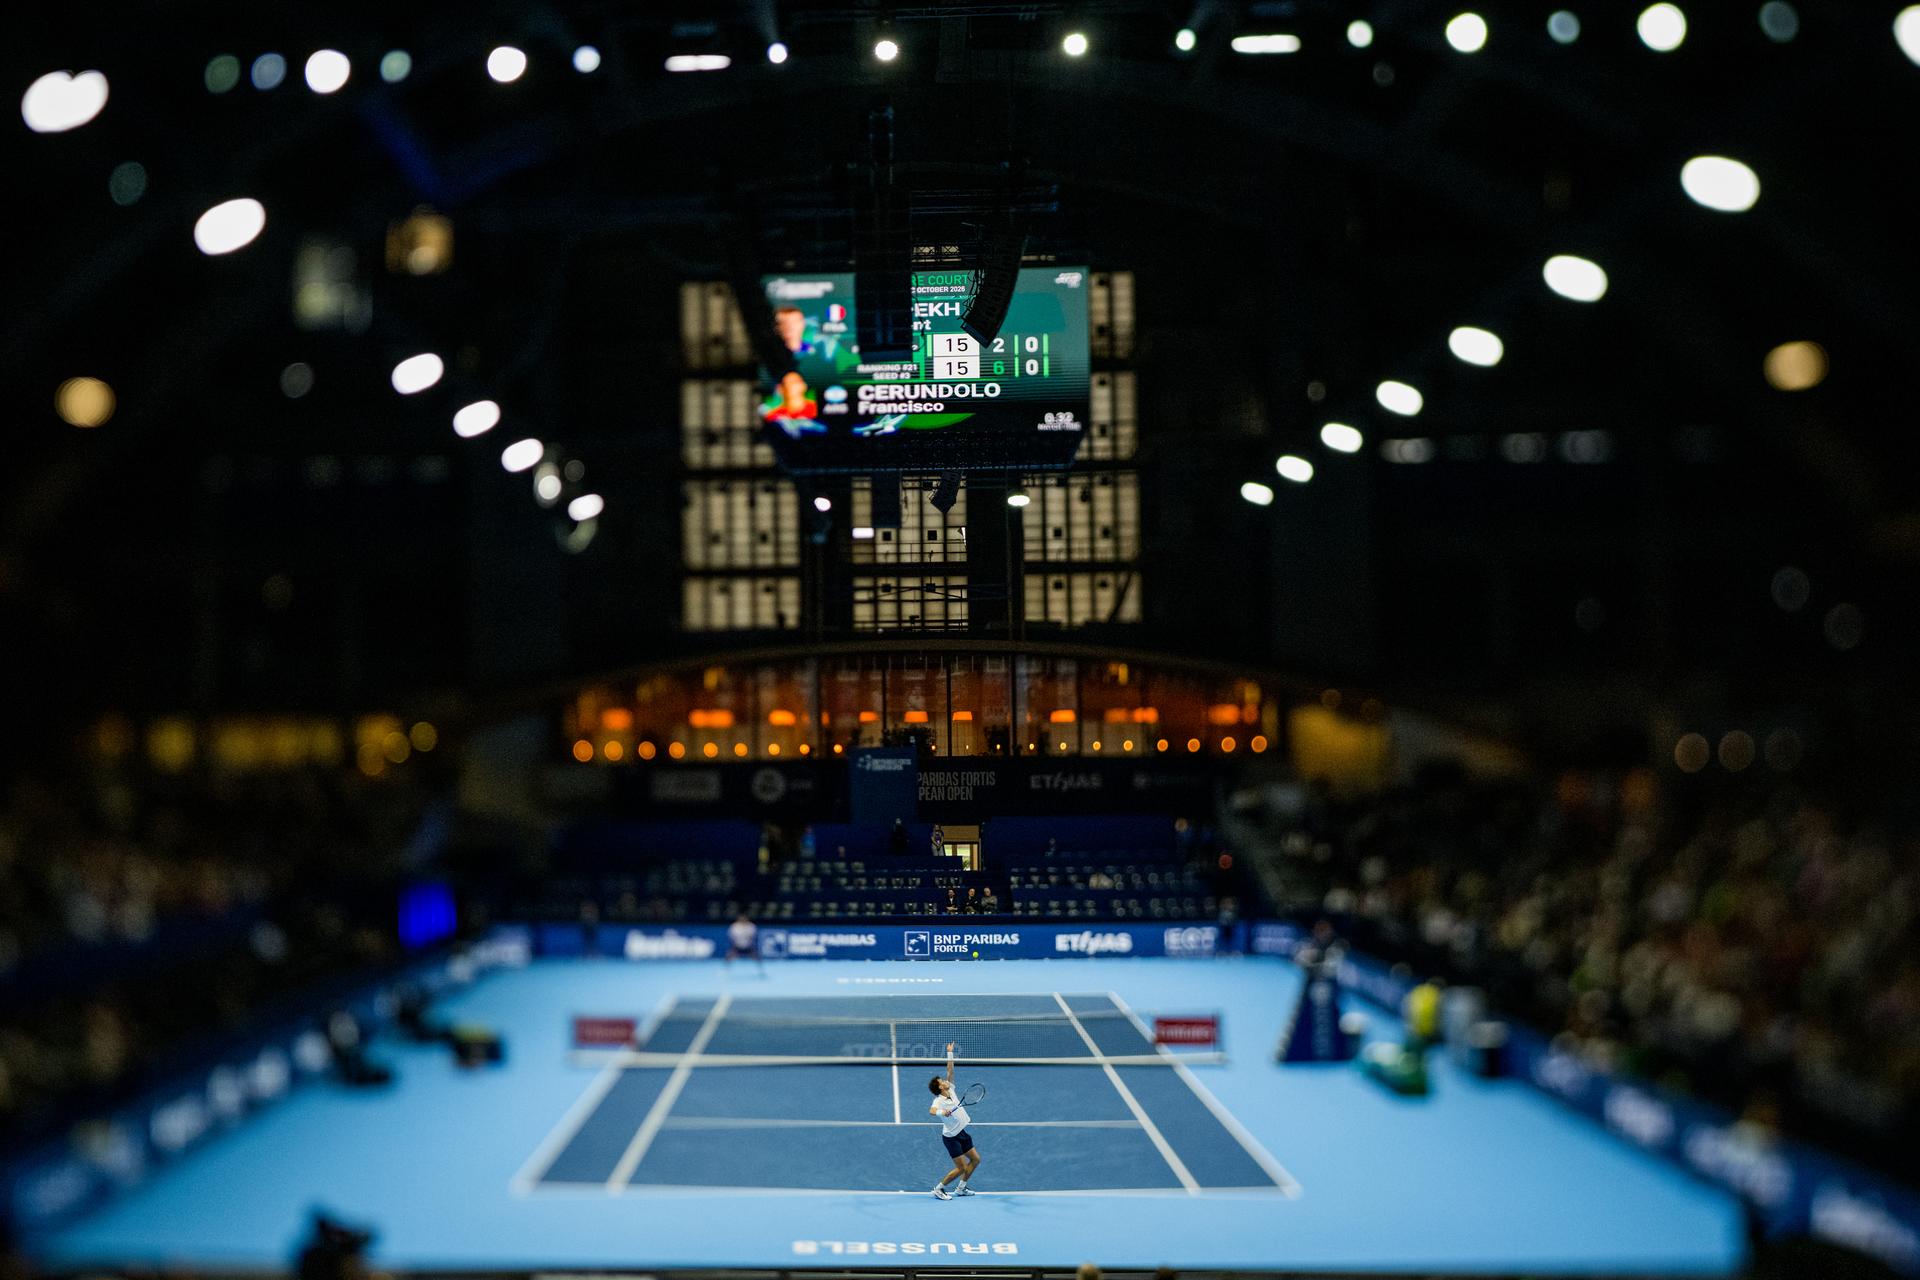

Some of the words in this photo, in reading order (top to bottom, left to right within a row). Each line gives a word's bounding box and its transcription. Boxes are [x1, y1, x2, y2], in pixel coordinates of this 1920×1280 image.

[911, 275, 925, 286] RE
[928, 274, 968, 286] COURT
[912, 302, 960, 317] EKH
[912, 319, 931, 331] nt
[946, 338, 968, 352] 15
[993, 338, 1005, 353] 2
[1025, 336, 1039, 353] 0
[946, 361, 968, 375] 15
[993, 361, 1005, 375] 6
[1025, 359, 1039, 376] 0
[857, 382, 1001, 401] CERUNDOLO
[858, 400, 945, 415] Francisco
[960, 771, 996, 786] FORTIS
[918, 786, 945, 800] PEAN
[947, 786, 973, 800] OPEN
[820, 934, 876, 946] PARIBAS
[933, 934, 961, 945] BNP
[963, 933, 1020, 945] PARIBAS
[933, 945, 968, 953] FORTIS
[792, 1240, 1019, 1255] BRUSSELS
